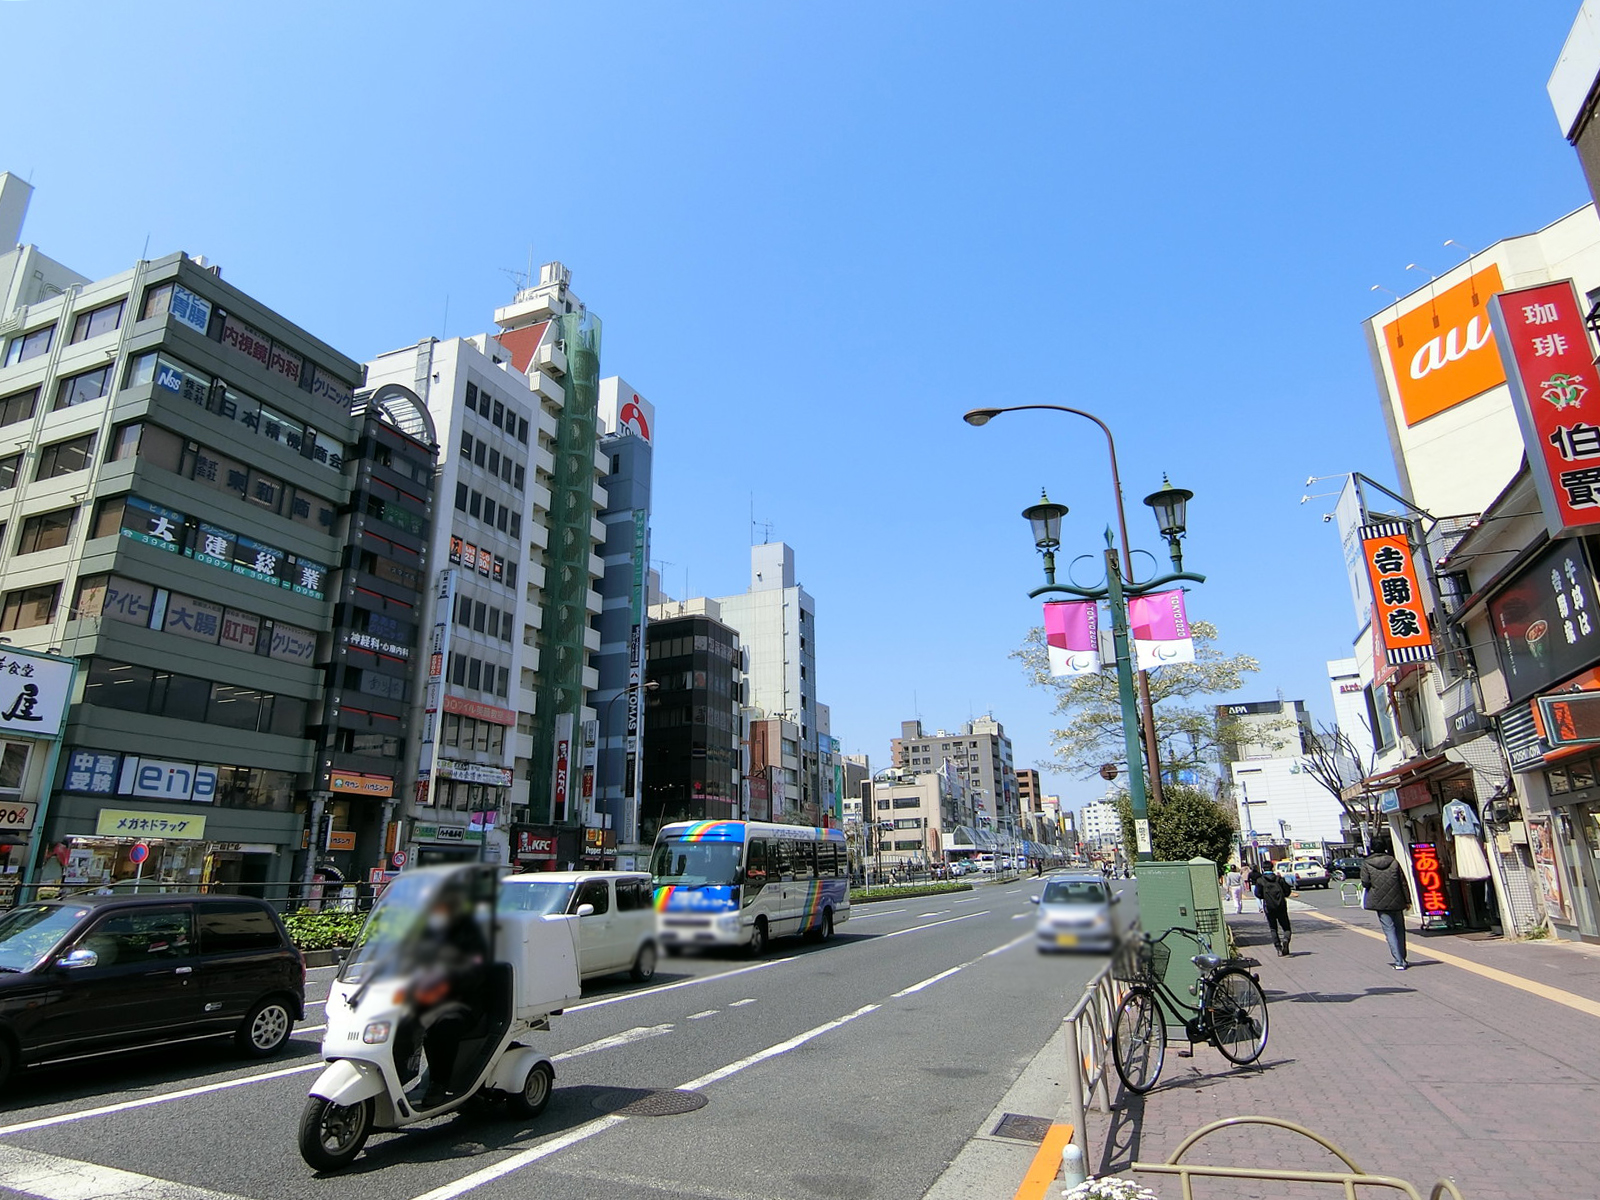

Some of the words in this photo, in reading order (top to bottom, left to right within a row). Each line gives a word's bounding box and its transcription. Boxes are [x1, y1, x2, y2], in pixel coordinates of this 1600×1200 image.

[1521, 302, 1569, 358] 珈琲
[222, 326, 269, 364] 内視鏡
[269, 352, 300, 382] 内科
[1410, 315, 1492, 380] au
[158, 369, 182, 391] NSS
[313, 377, 351, 411] クリニック
[1373, 545, 1422, 638] 吉野家
[1087, 606, 1097, 630] TOKYO
[1171, 595, 1183, 619] TOKYO
[169, 607, 218, 637] 大腸
[222, 620, 257, 647] 肛門
[1176, 620, 1185, 637] 2020
[272, 632, 315, 660] クリニック
[1089, 631, 1097, 649] 2020
[1, 683, 43, 721] 屋
[628, 688, 638, 730] TOMAS
[1228, 706, 1248, 715] APA
[74, 752, 116, 773] 中高
[69, 771, 112, 793] 受験
[137, 764, 217, 797] ena
[557, 769, 566, 795] KFC
[116, 817, 190, 832] メガネドラッグ
[532, 839, 551, 851] KFC
[1413, 847, 1447, 910] ありま
